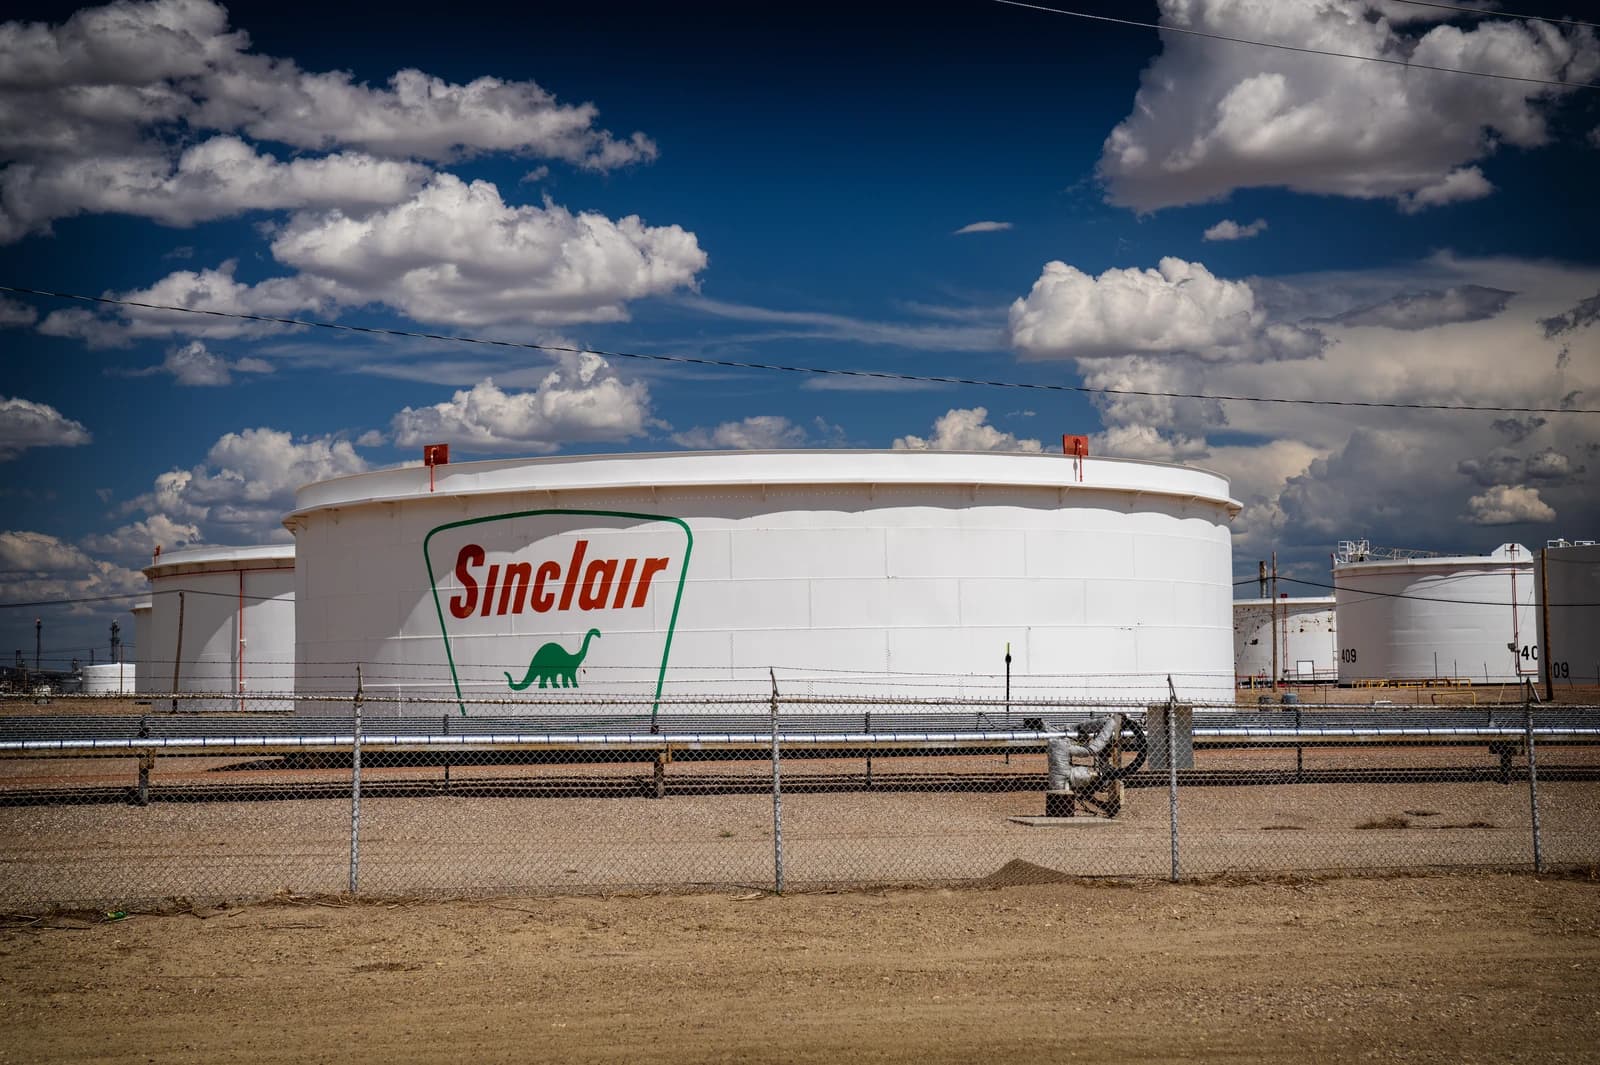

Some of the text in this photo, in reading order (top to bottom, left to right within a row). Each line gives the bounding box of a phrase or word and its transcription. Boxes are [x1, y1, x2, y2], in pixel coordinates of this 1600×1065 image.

[450, 540, 670, 619] Sinclair
[1341, 648, 1357, 664] 409
[1551, 661, 1570, 679] 09
